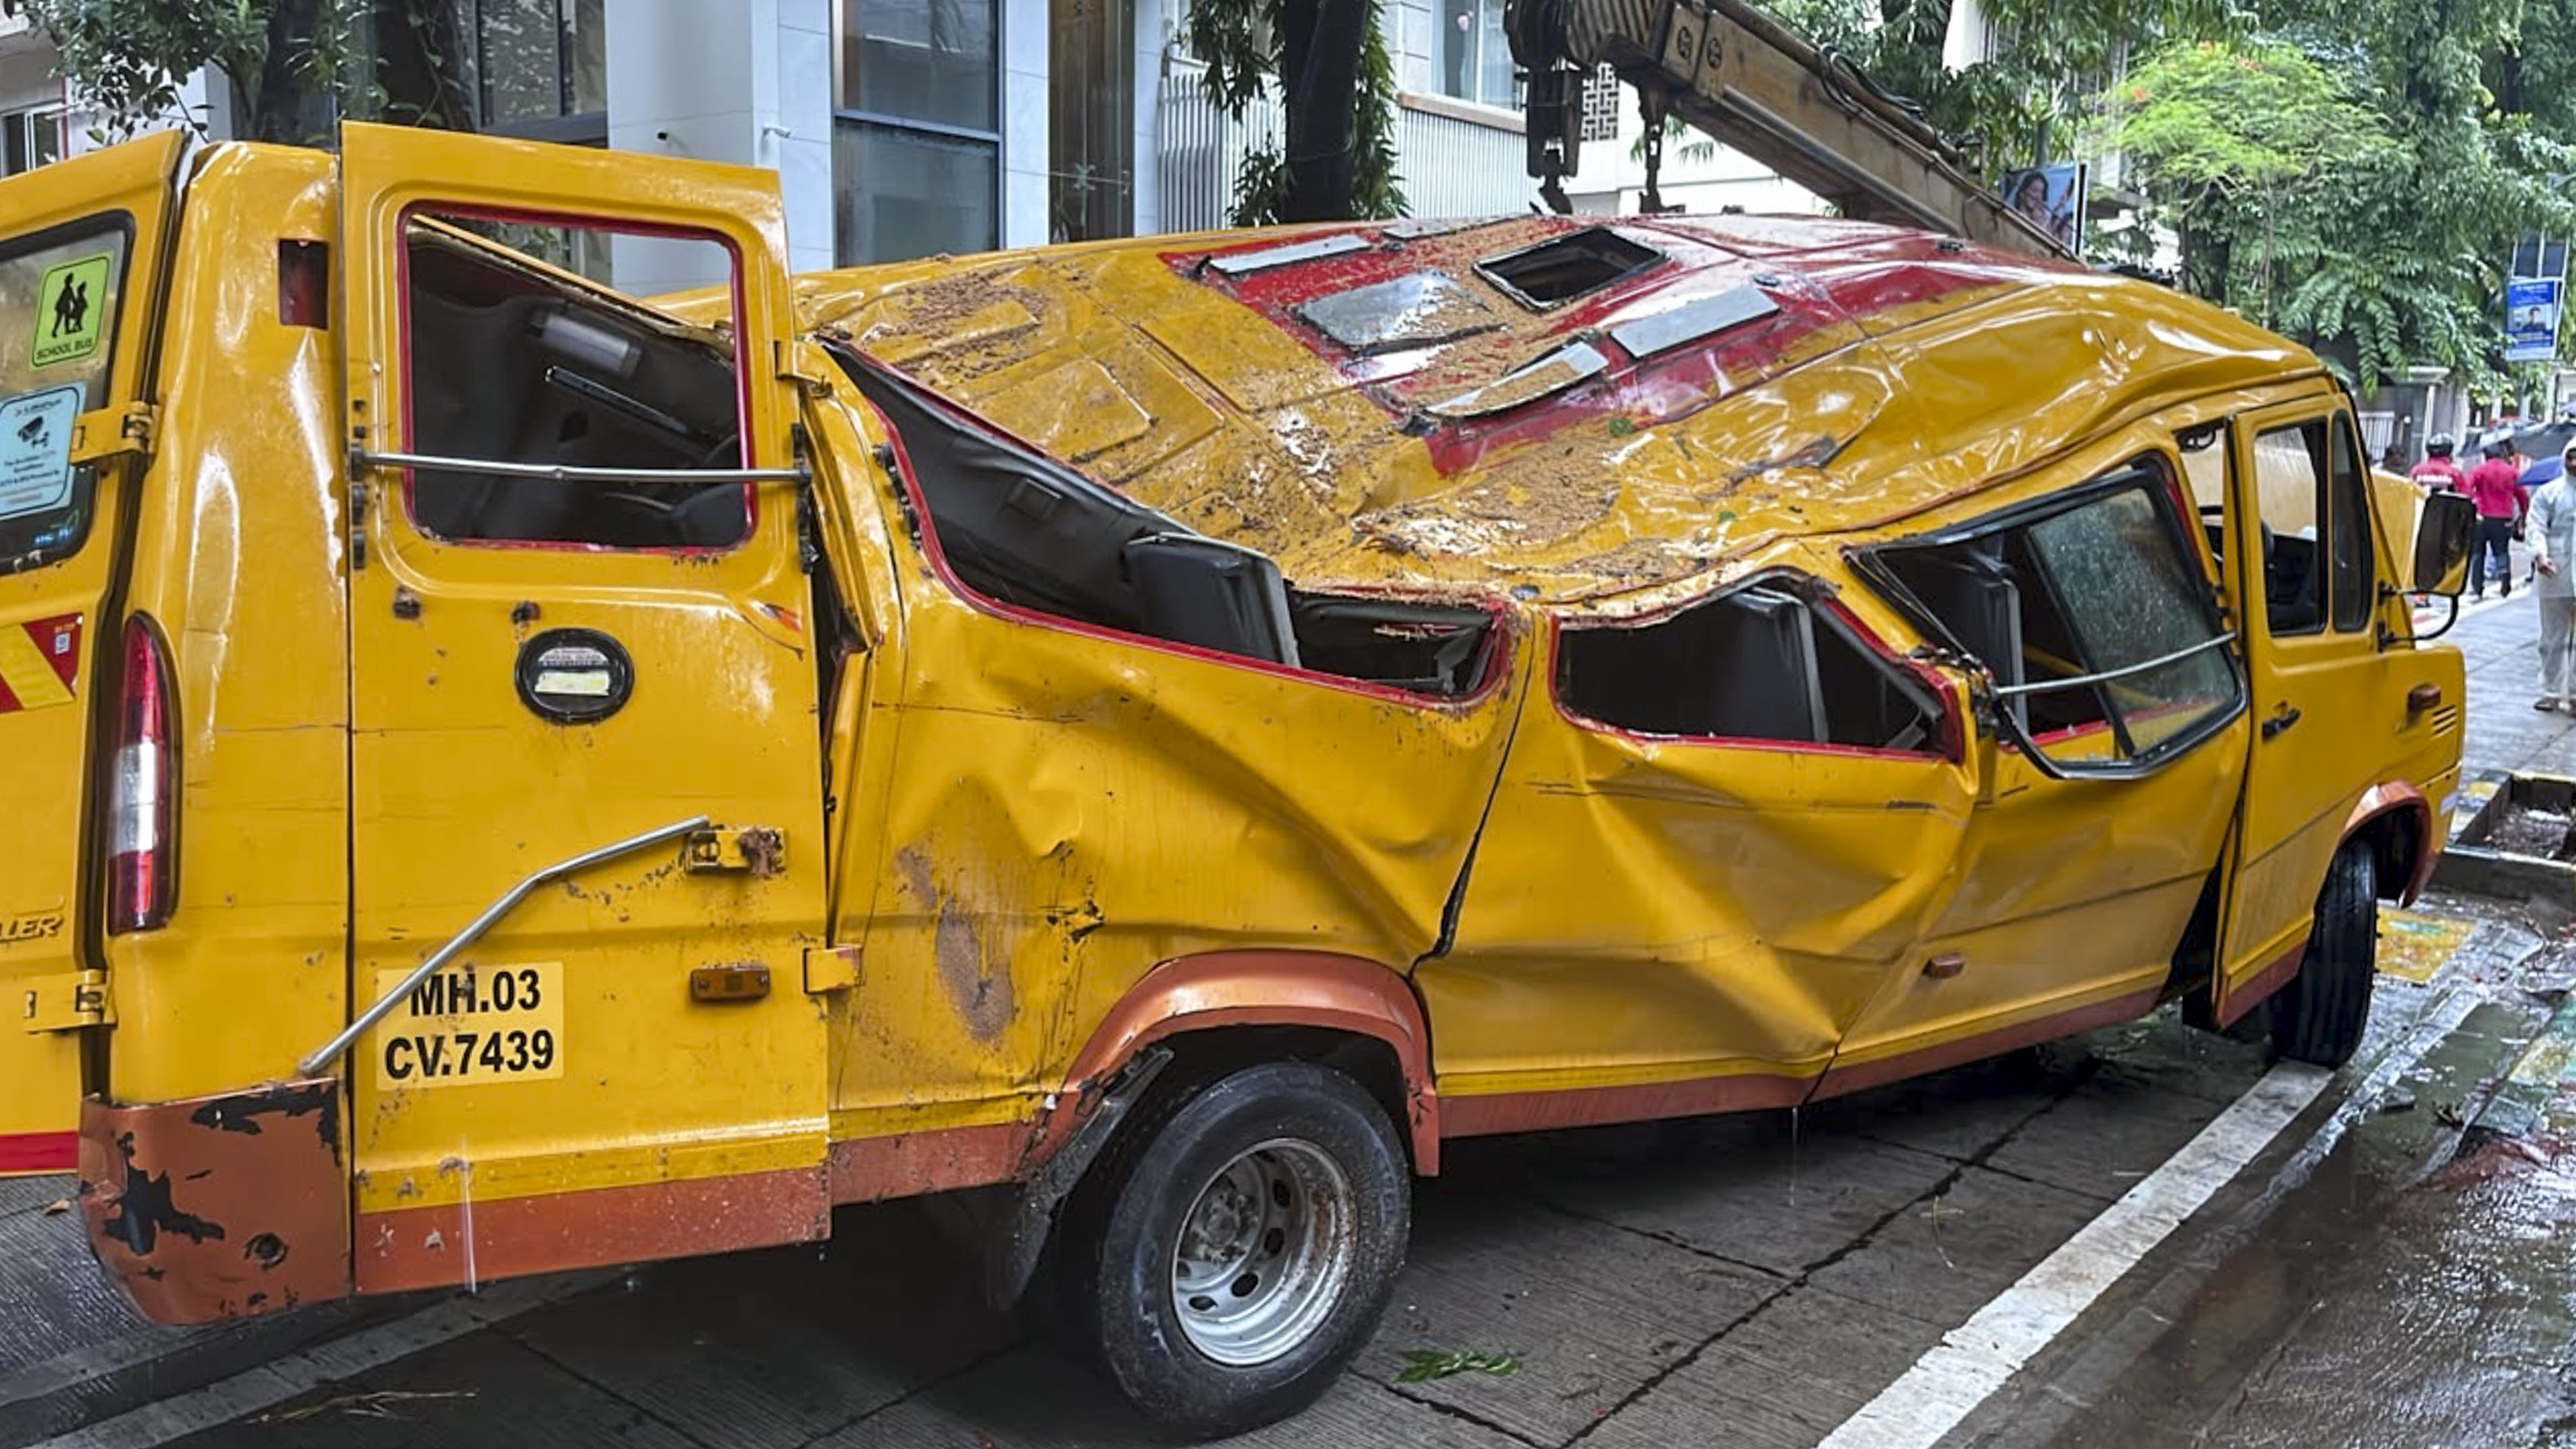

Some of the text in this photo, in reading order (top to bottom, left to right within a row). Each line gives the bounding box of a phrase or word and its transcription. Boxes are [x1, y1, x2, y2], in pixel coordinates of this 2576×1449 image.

[36, 338, 93, 360] SCHOOL BUS
[0, 915, 64, 941] LER
[411, 969, 540, 1016] MH.03
[385, 1029, 553, 1080] CV.7439
